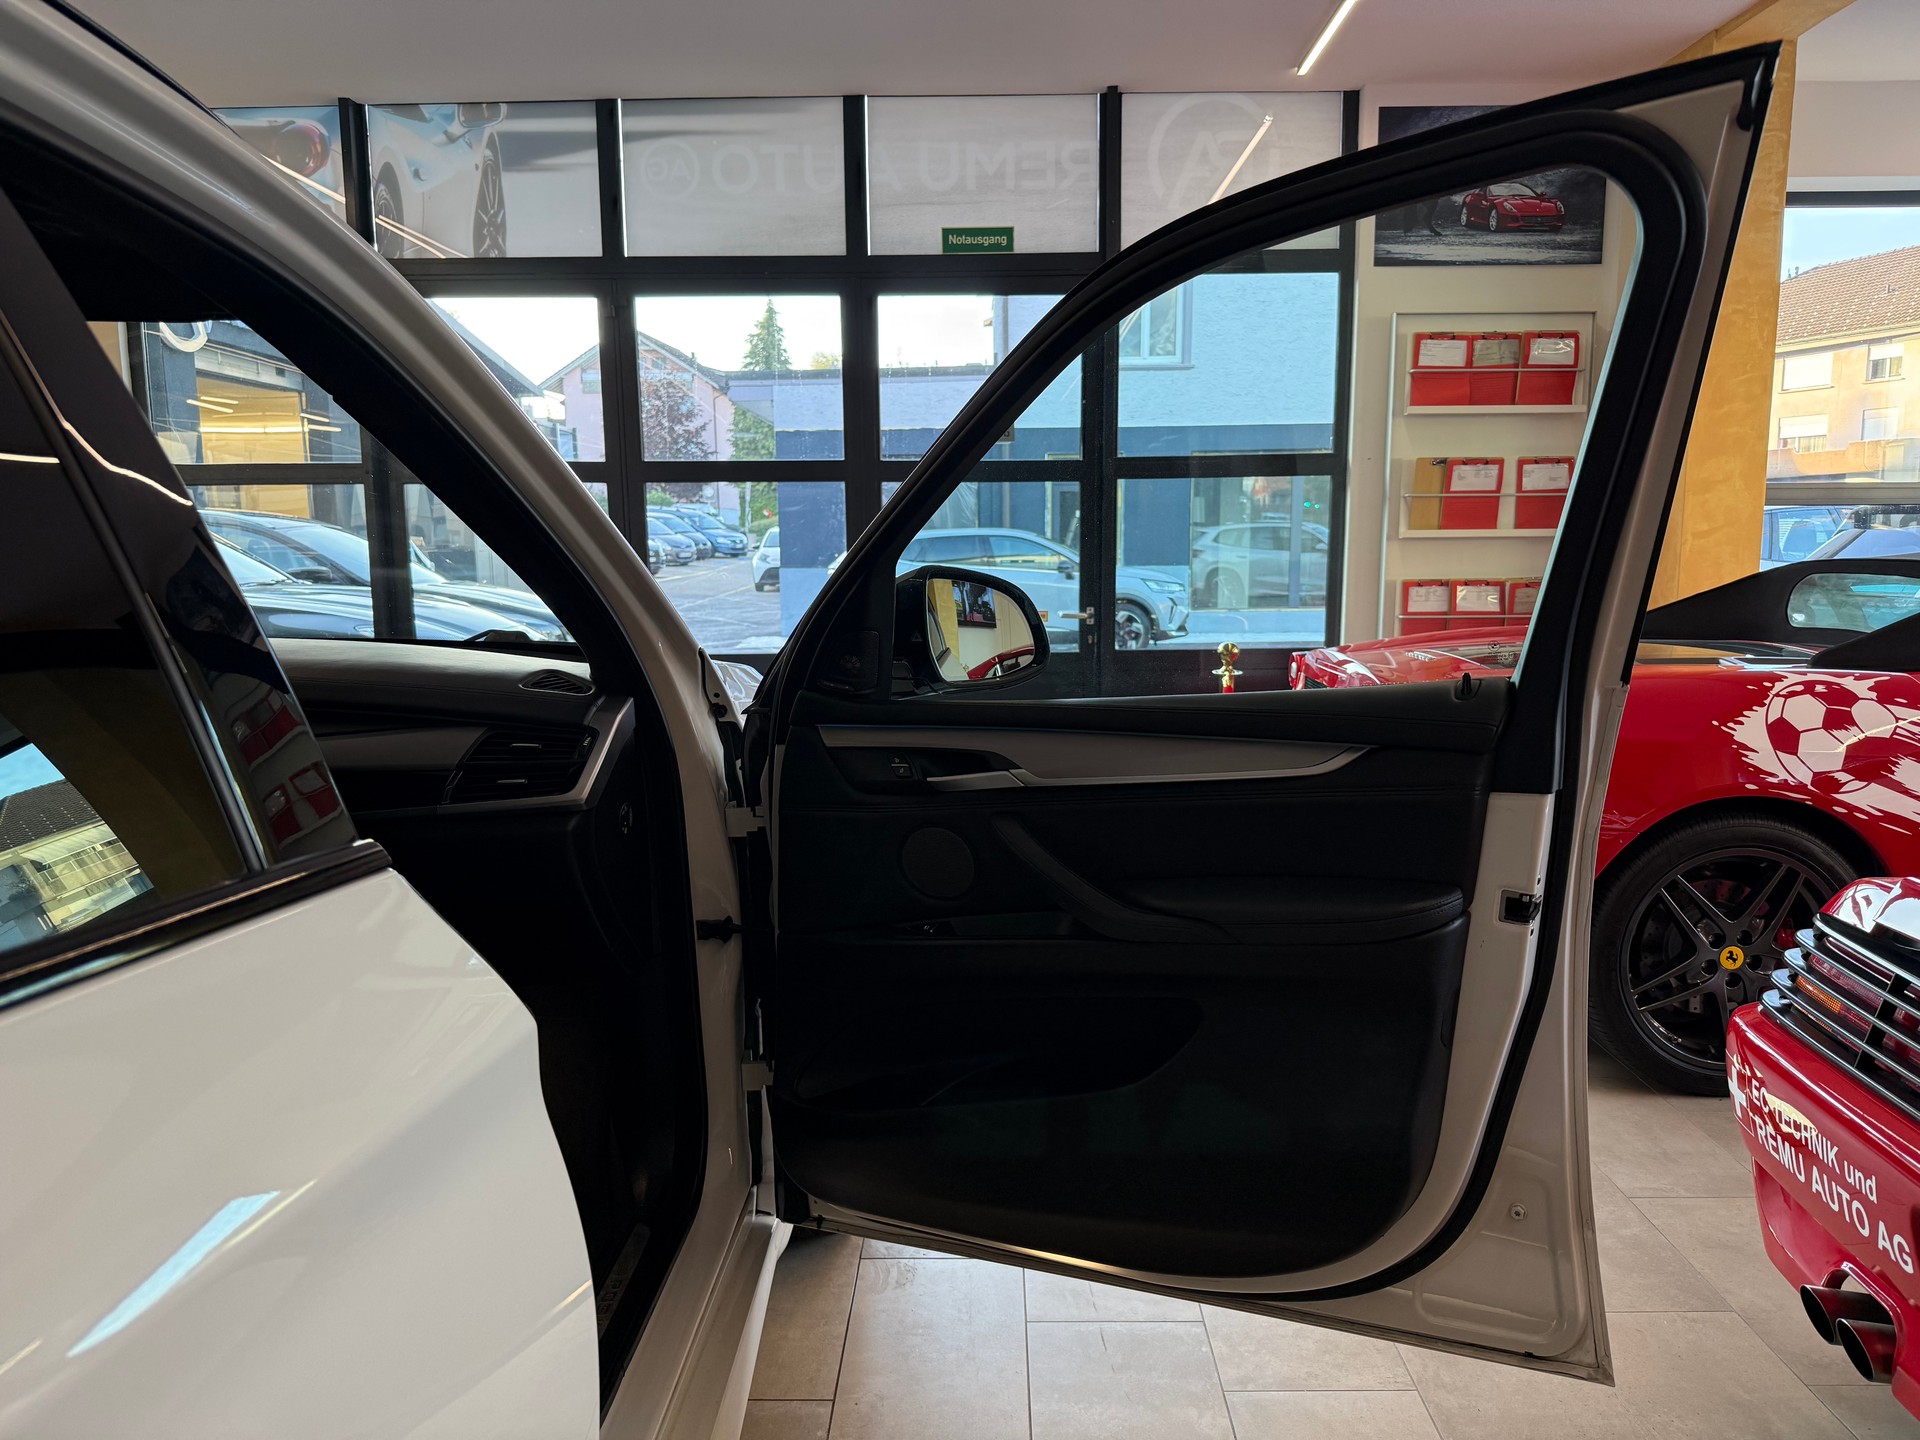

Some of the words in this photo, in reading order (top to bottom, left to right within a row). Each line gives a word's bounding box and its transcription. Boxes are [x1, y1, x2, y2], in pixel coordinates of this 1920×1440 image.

[948, 234, 1008, 247] Notausgang
[1756, 1117, 1805, 1183] REMU
[1812, 1165, 1870, 1238] AUTO
[1878, 1219, 1914, 1275] AG
[1844, 1160, 1877, 1204] und
